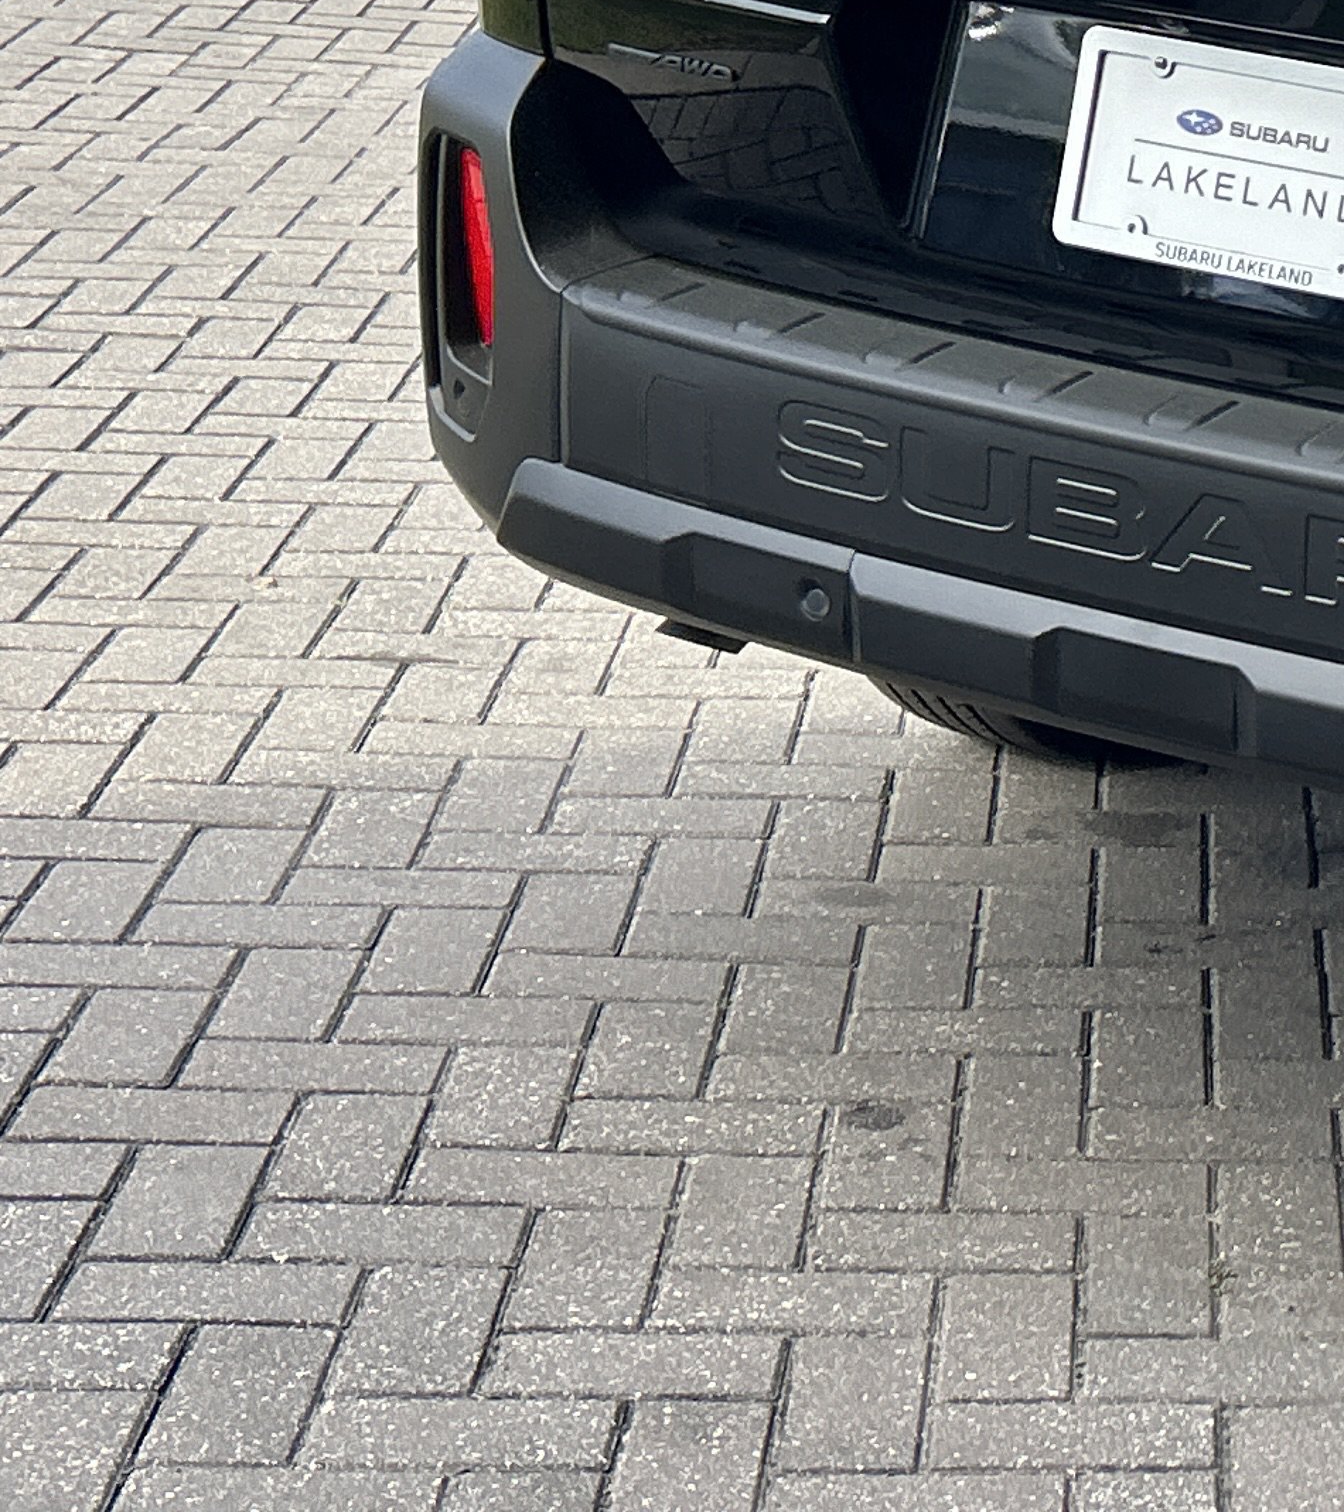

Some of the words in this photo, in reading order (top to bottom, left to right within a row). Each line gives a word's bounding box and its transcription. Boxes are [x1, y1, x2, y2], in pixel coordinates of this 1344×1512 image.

[1229, 120, 1330, 153] SUBARU
[1154, 241, 1222, 269] SUBARU
[1226, 255, 1314, 287] LAKELAND
